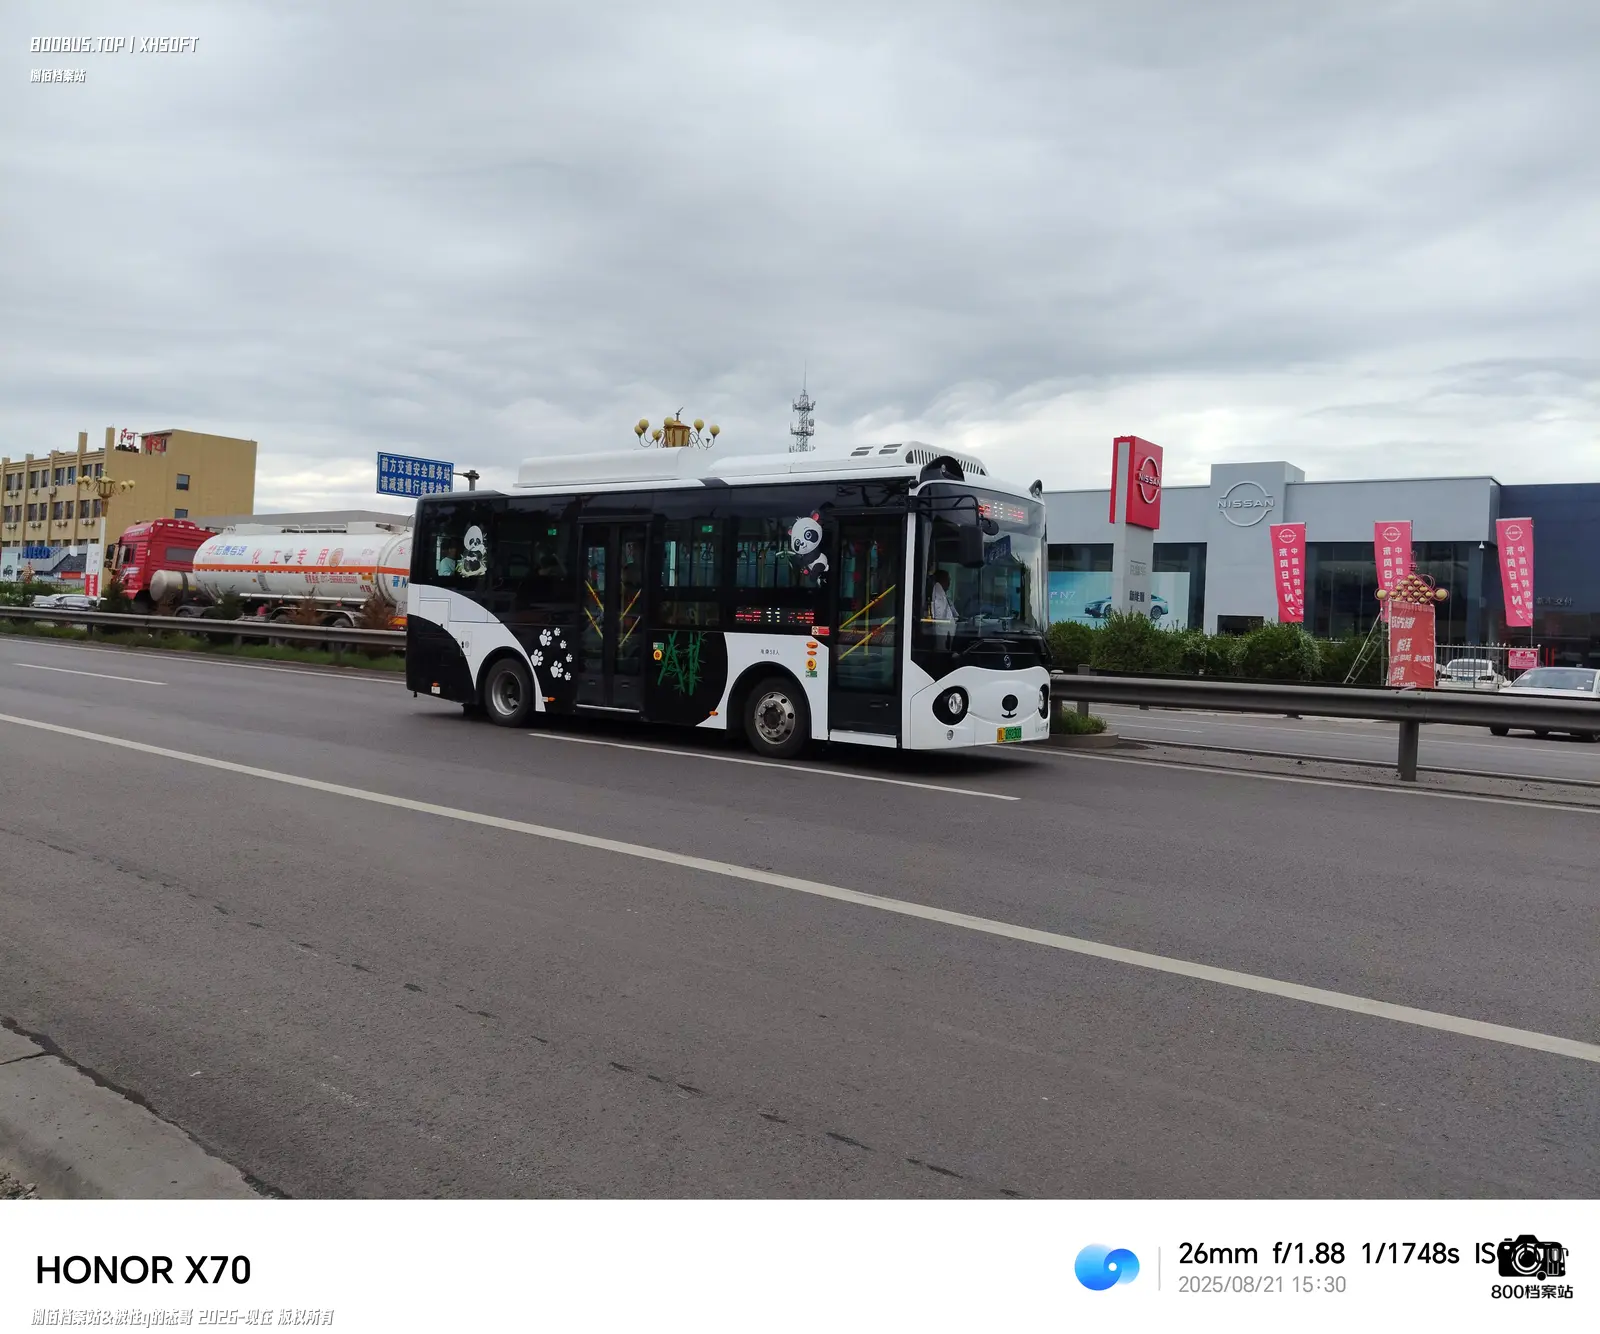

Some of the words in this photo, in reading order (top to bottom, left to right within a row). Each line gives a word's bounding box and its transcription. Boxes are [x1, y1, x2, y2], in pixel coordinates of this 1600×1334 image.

[381, 457, 450, 481] 前方交通安全服务站
[1138, 473, 1161, 487] NISSAN
[1217, 499, 1275, 509] NISSAN
[24, 545, 50, 558] IVECO
